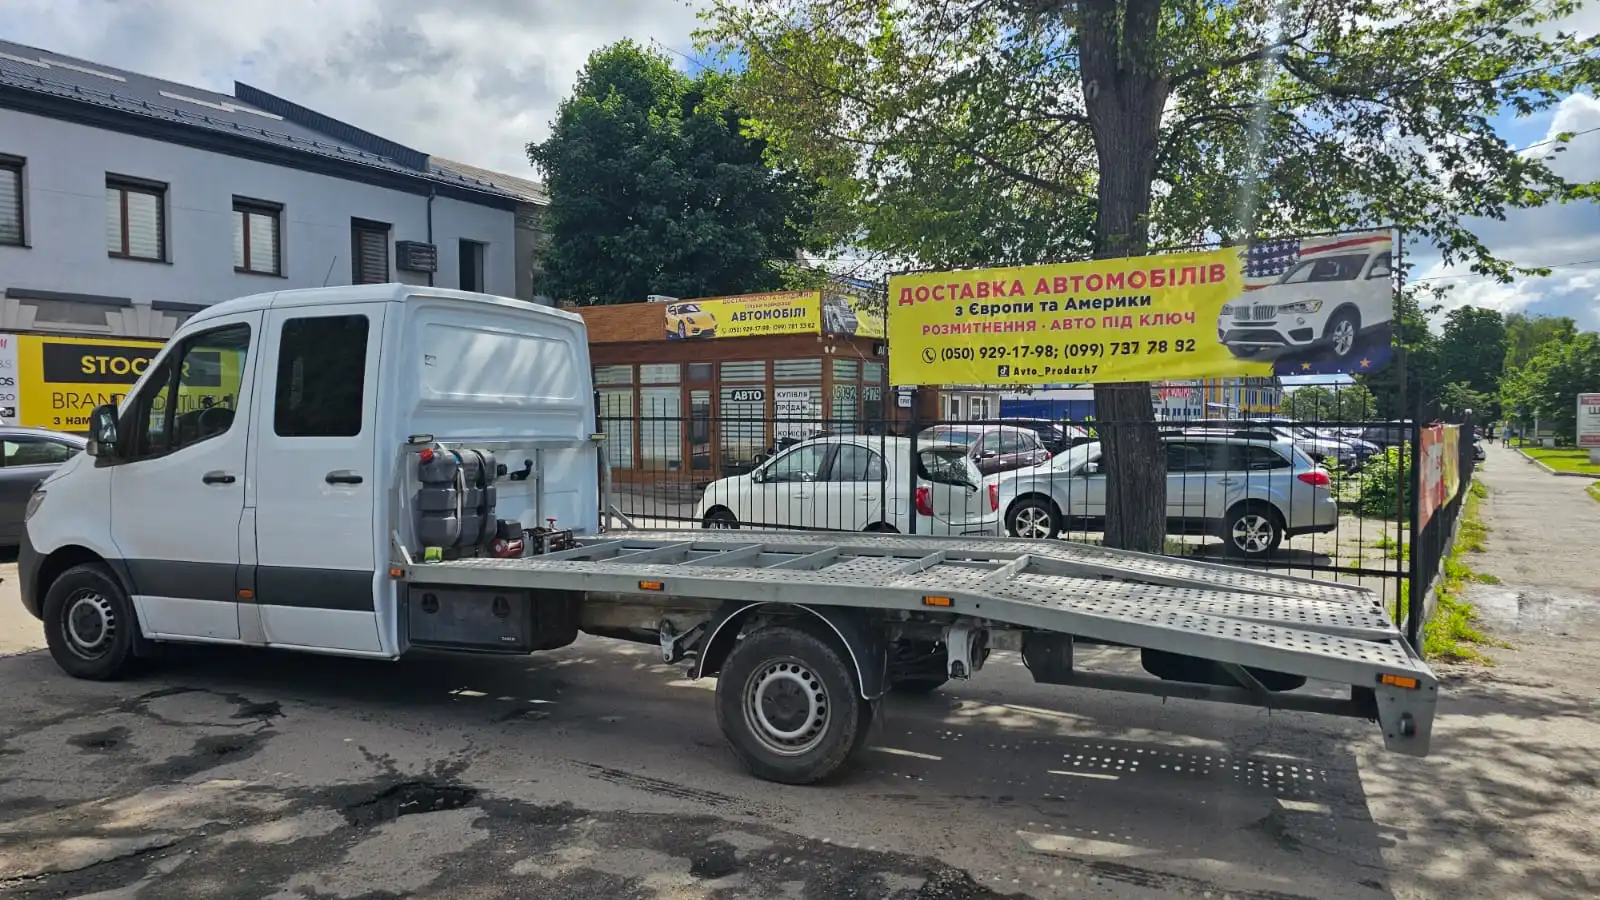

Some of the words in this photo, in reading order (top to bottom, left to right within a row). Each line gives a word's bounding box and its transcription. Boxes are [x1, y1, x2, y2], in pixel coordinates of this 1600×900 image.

[898, 279, 1025, 306] ДОСТАВКА
[1034, 263, 1226, 295] АВТОМОБІЛІВ
[731, 307, 806, 322] АВТОМОБІЛІ
[955, 306, 963, 316] з
[969, 302, 1034, 317] Європи
[1039, 300, 1058, 312] та
[1065, 295, 1151, 311] Америки
[922, 320, 1036, 336] РОЗМИТНЕННЯ
[1051, 317, 1096, 331] АВТО
[1103, 315, 1132, 329] ПІД
[1140, 312, 1195, 326] КЛЮЧ
[941, 348, 975, 361] (050)
[979, 345, 1058, 359] 929-17-98;
[1064, 343, 1104, 358] (099)
[1110, 341, 1140, 355] 737
[1147, 340, 1168, 355] 78
[1014, 364, 1098, 377] Avto_Prodazh7
[734, 390, 762, 400] АВТО
